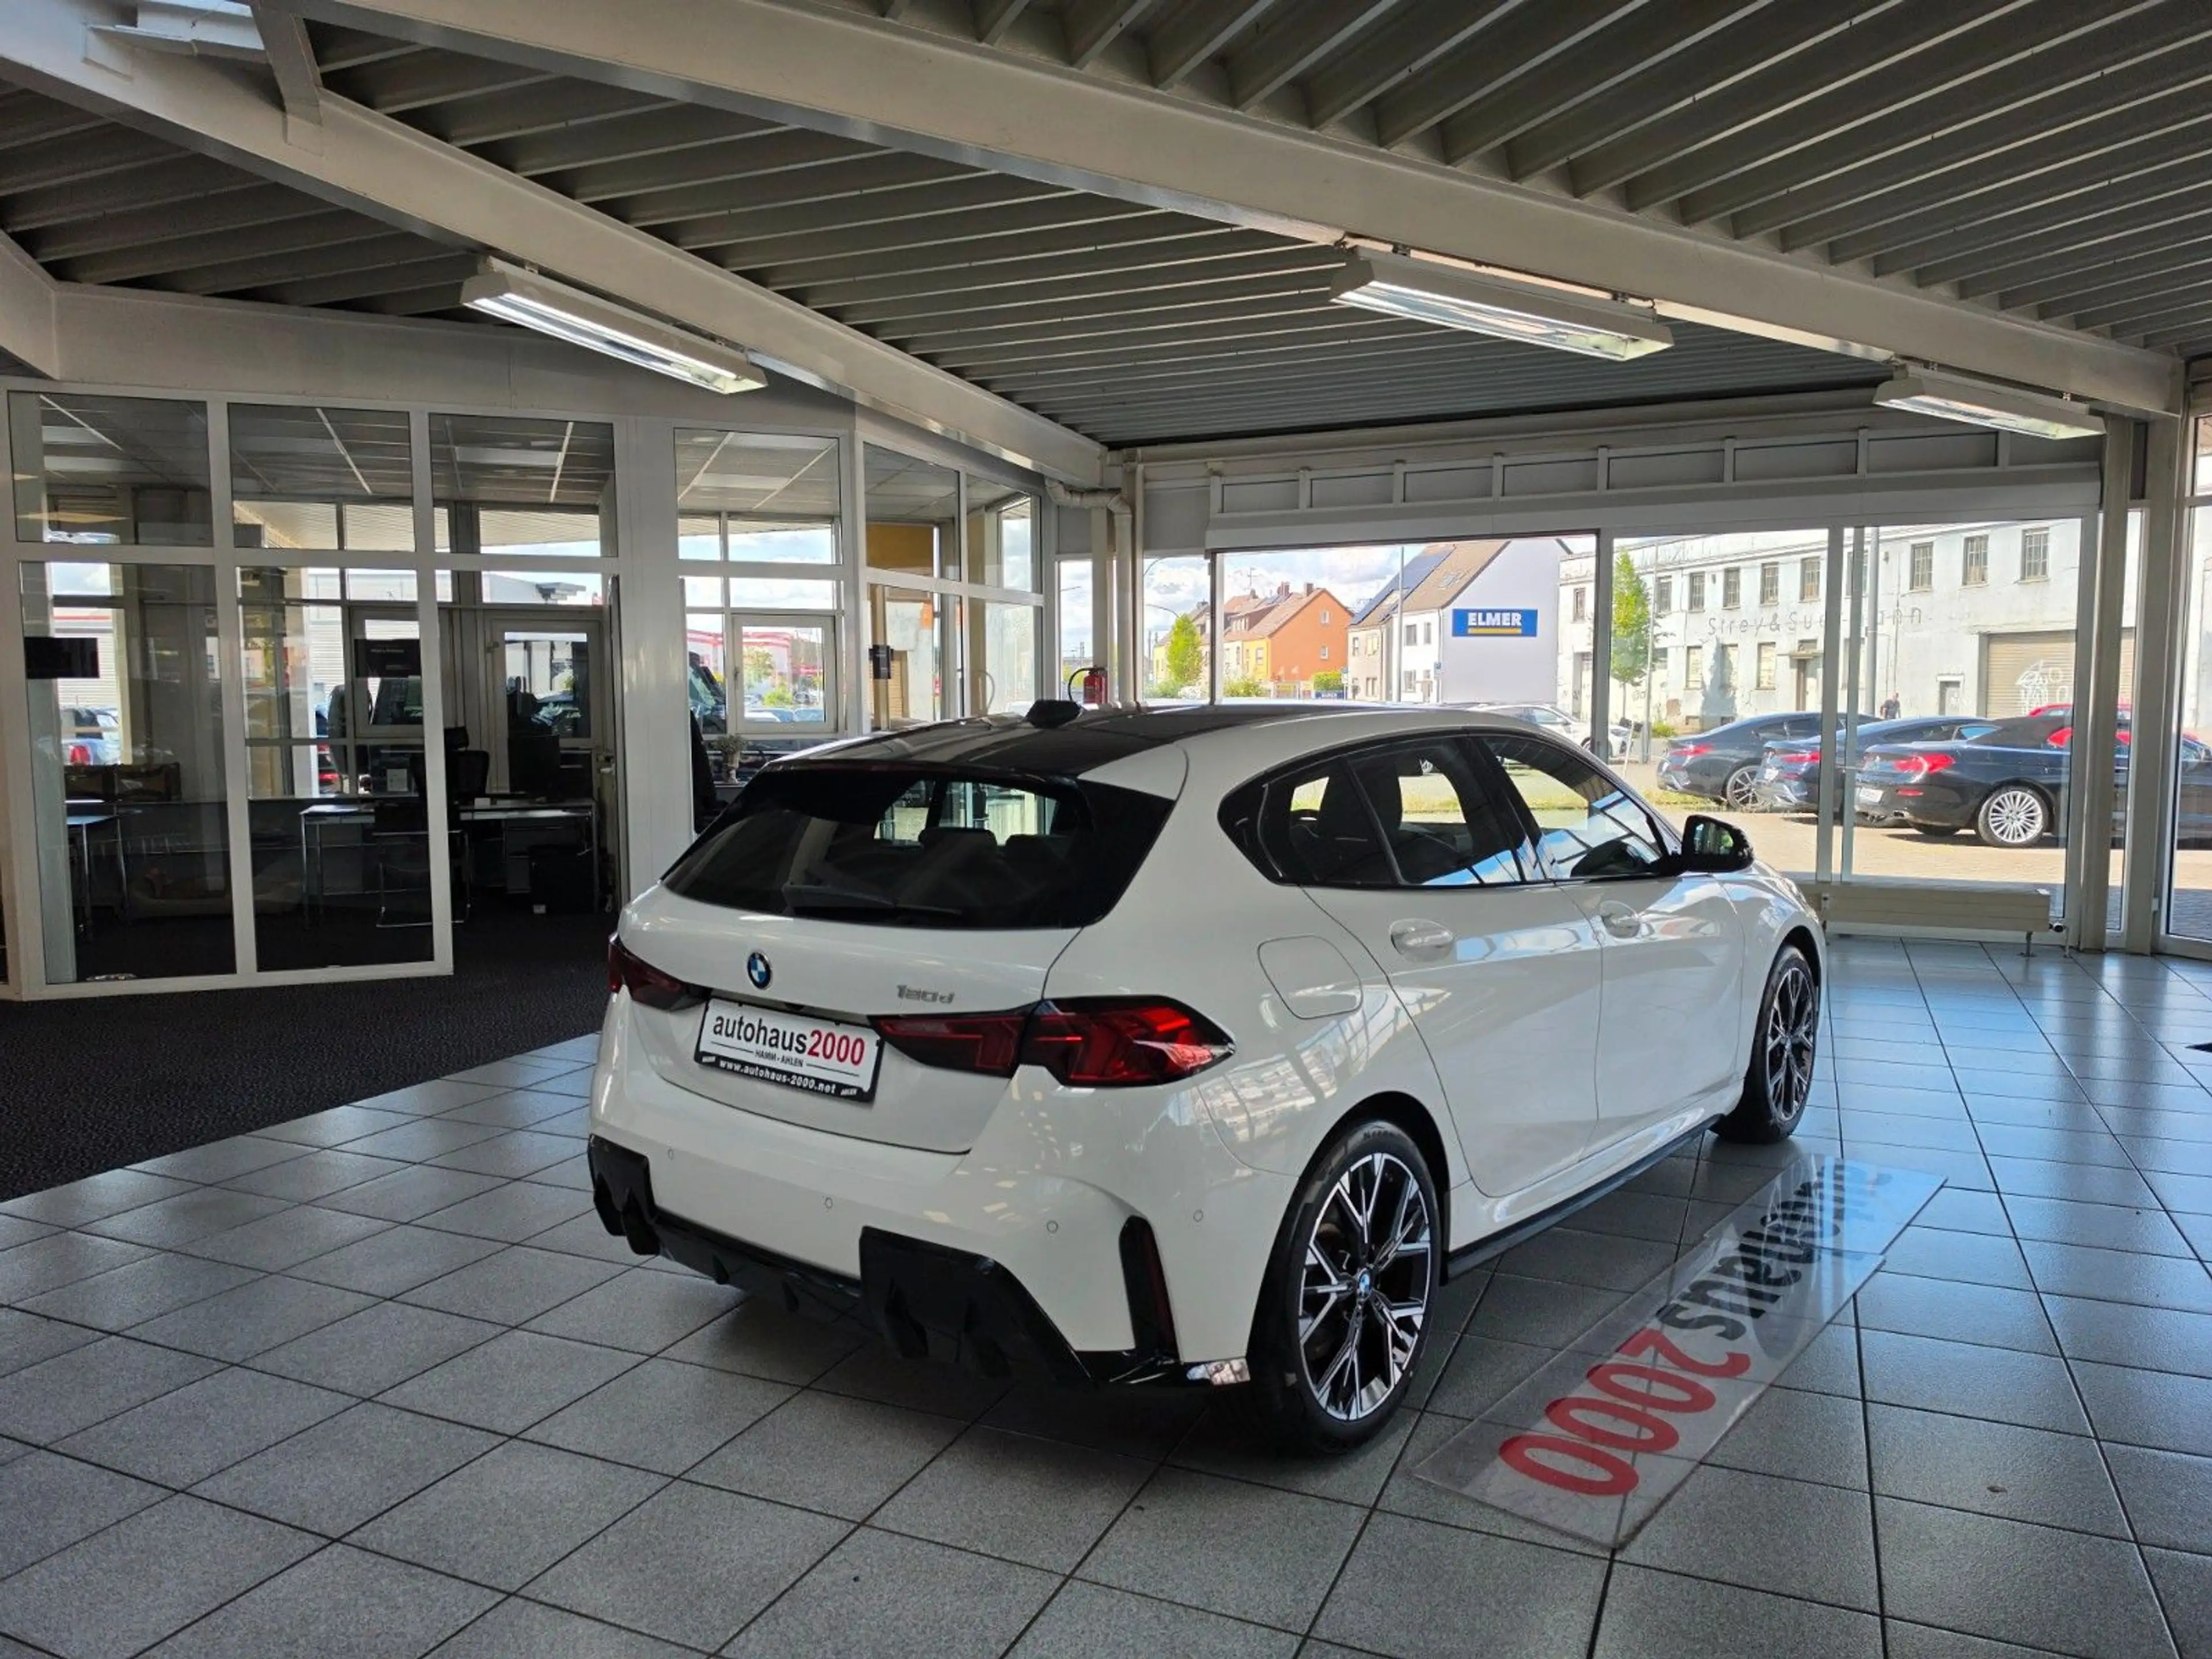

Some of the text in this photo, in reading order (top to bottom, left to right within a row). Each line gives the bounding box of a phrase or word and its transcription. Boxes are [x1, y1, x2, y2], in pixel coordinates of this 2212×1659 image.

[1468, 612, 1522, 626] ELMER
[896, 984, 956, 1005] 120d
[713, 1016, 865, 1066] autohaus2000
[720, 1060, 836, 1094] www.autohaus-2000.net
